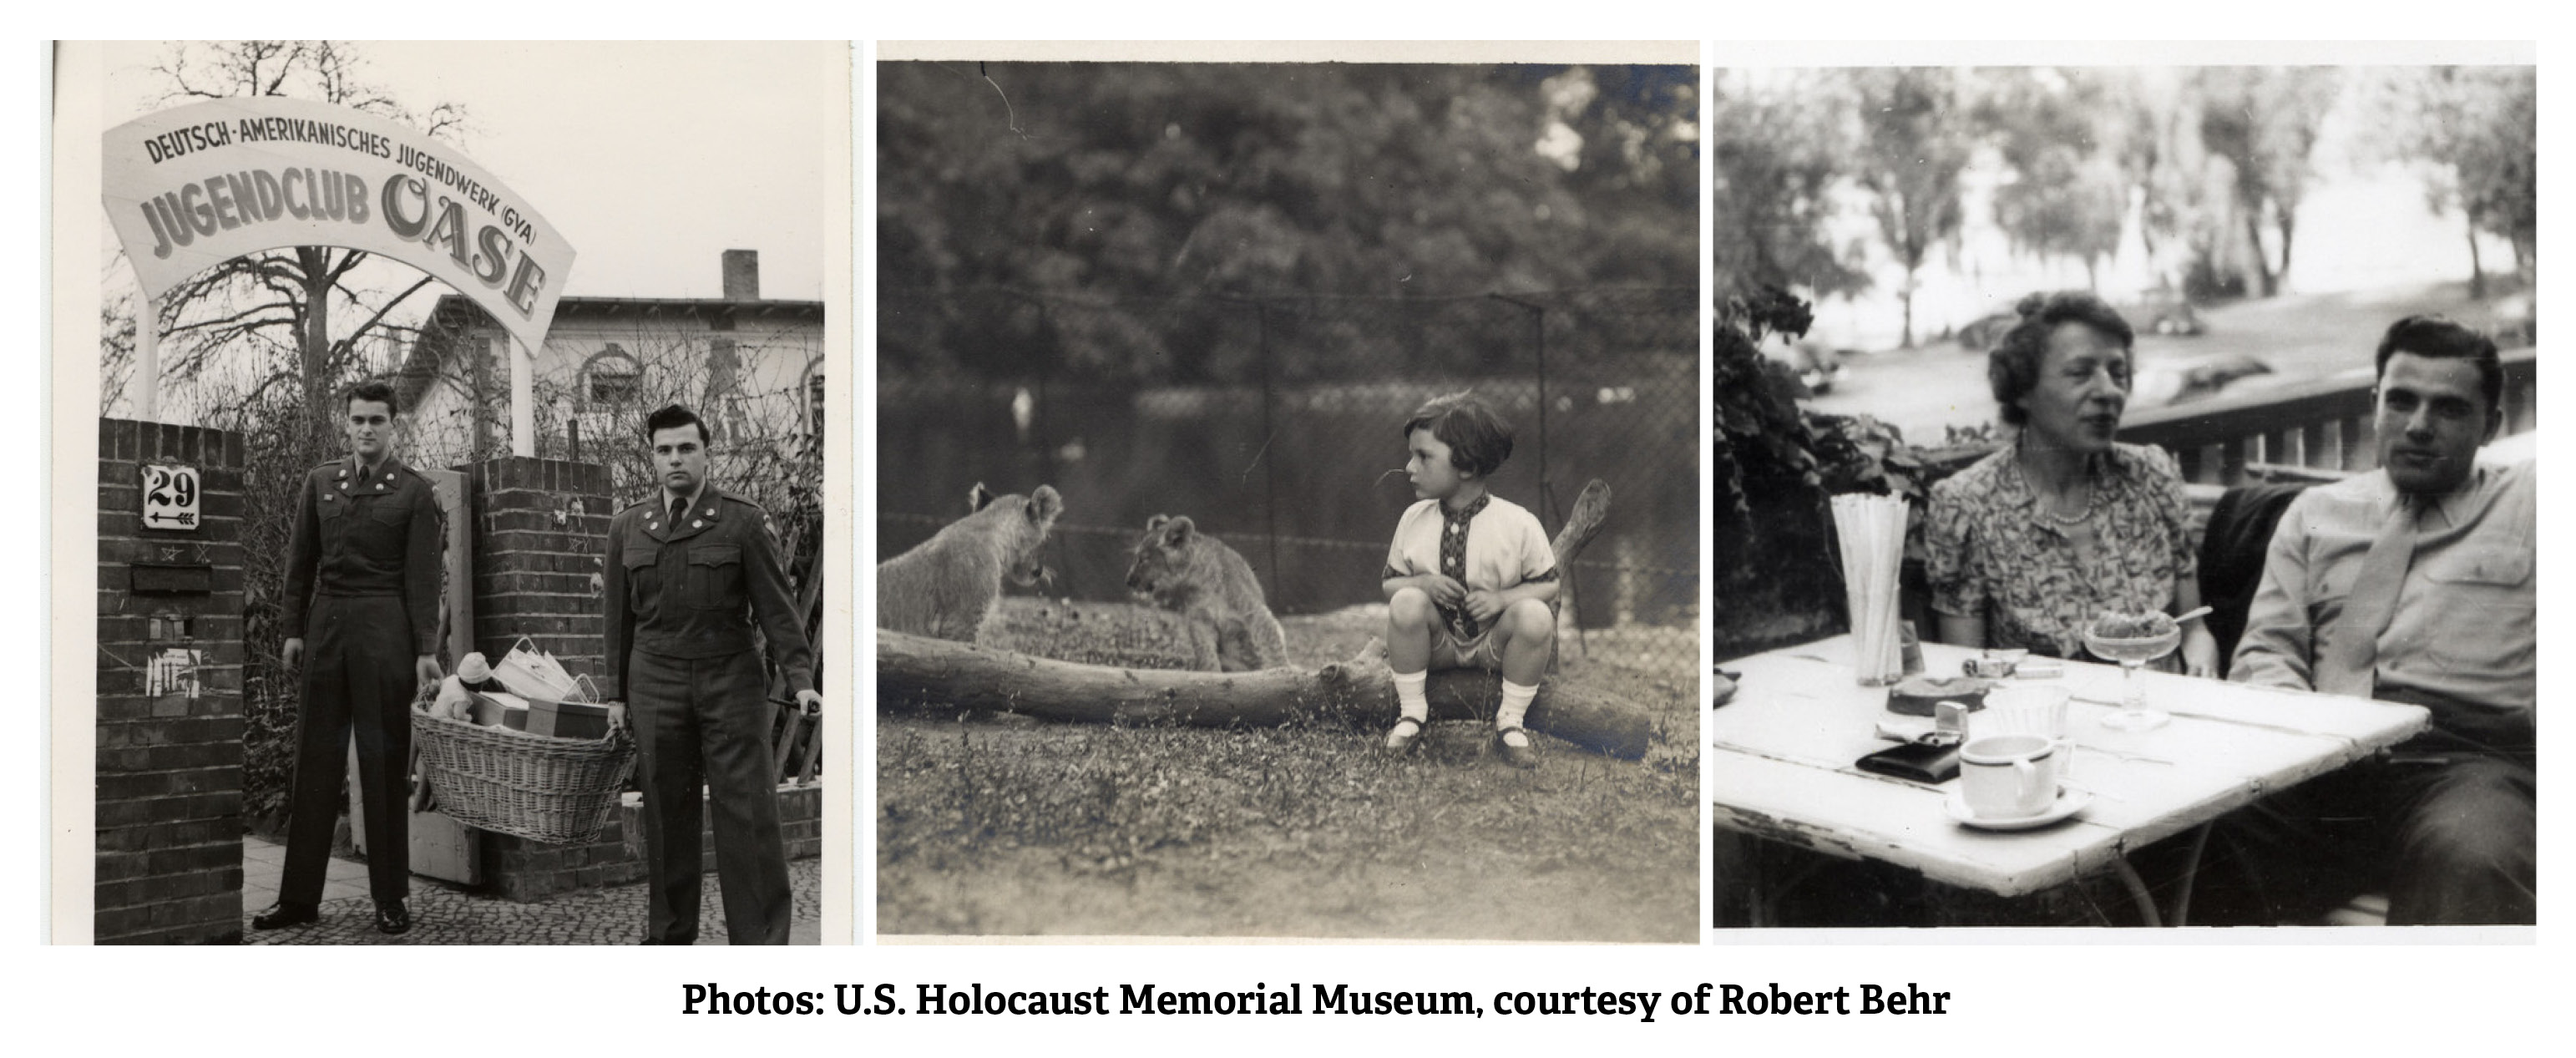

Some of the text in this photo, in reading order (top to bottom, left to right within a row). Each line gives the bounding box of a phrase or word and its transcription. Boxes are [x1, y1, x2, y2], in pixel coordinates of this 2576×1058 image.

[396, 143, 501, 217] JUGENDWERK
[140, 166, 547, 321] JUGENDCLUB OASE
[148, 472, 195, 508] 29
